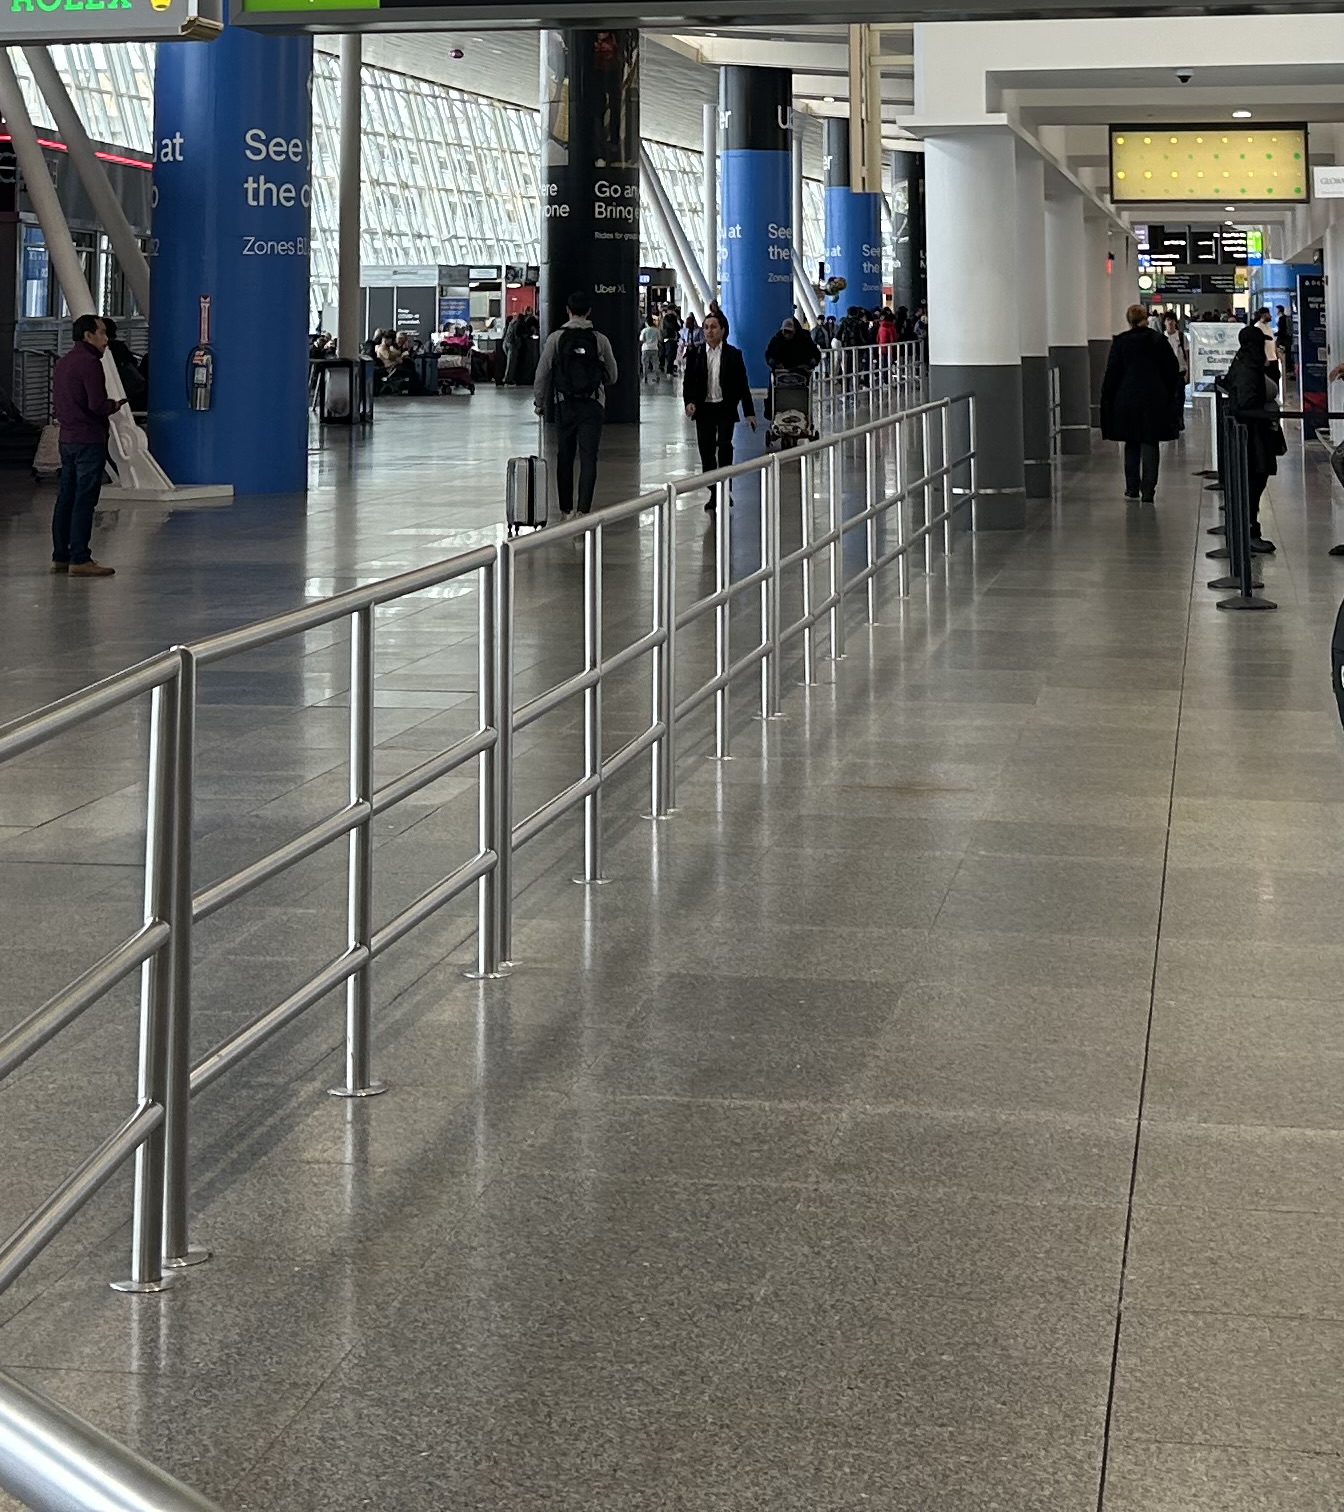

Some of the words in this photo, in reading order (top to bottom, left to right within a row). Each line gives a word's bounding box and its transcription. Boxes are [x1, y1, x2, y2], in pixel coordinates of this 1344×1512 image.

[160, 131, 184, 162] at
[244, 128, 303, 162] See
[243, 175, 296, 207] the
[594, 180, 622, 198] Go
[594, 201, 634, 223] Bring
[241, 236, 296, 256] Zones
[767, 244, 790, 261] the
